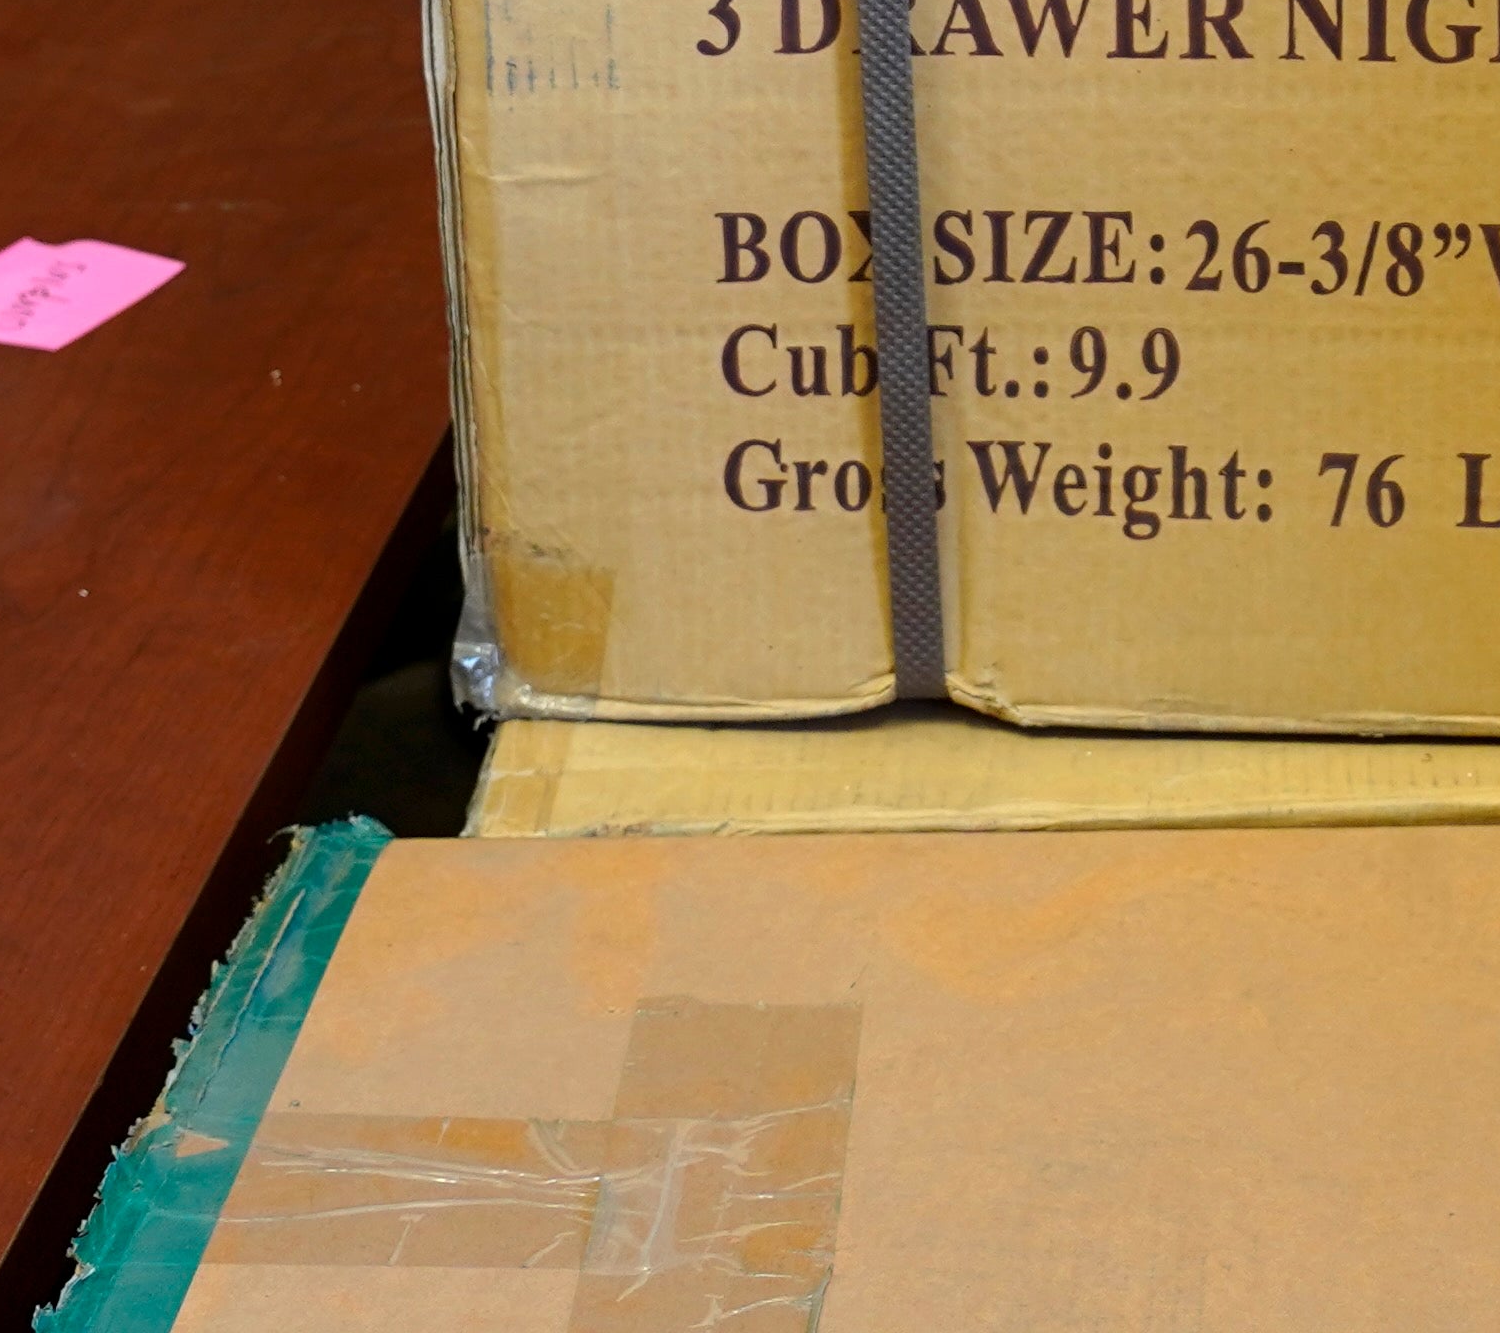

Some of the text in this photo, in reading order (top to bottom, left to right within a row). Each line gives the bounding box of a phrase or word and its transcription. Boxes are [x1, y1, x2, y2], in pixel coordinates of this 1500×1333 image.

[724, 439, 946, 513] Gro
[966, 441, 1272, 541] Weight:
[1319, 453, 1405, 528] 76
